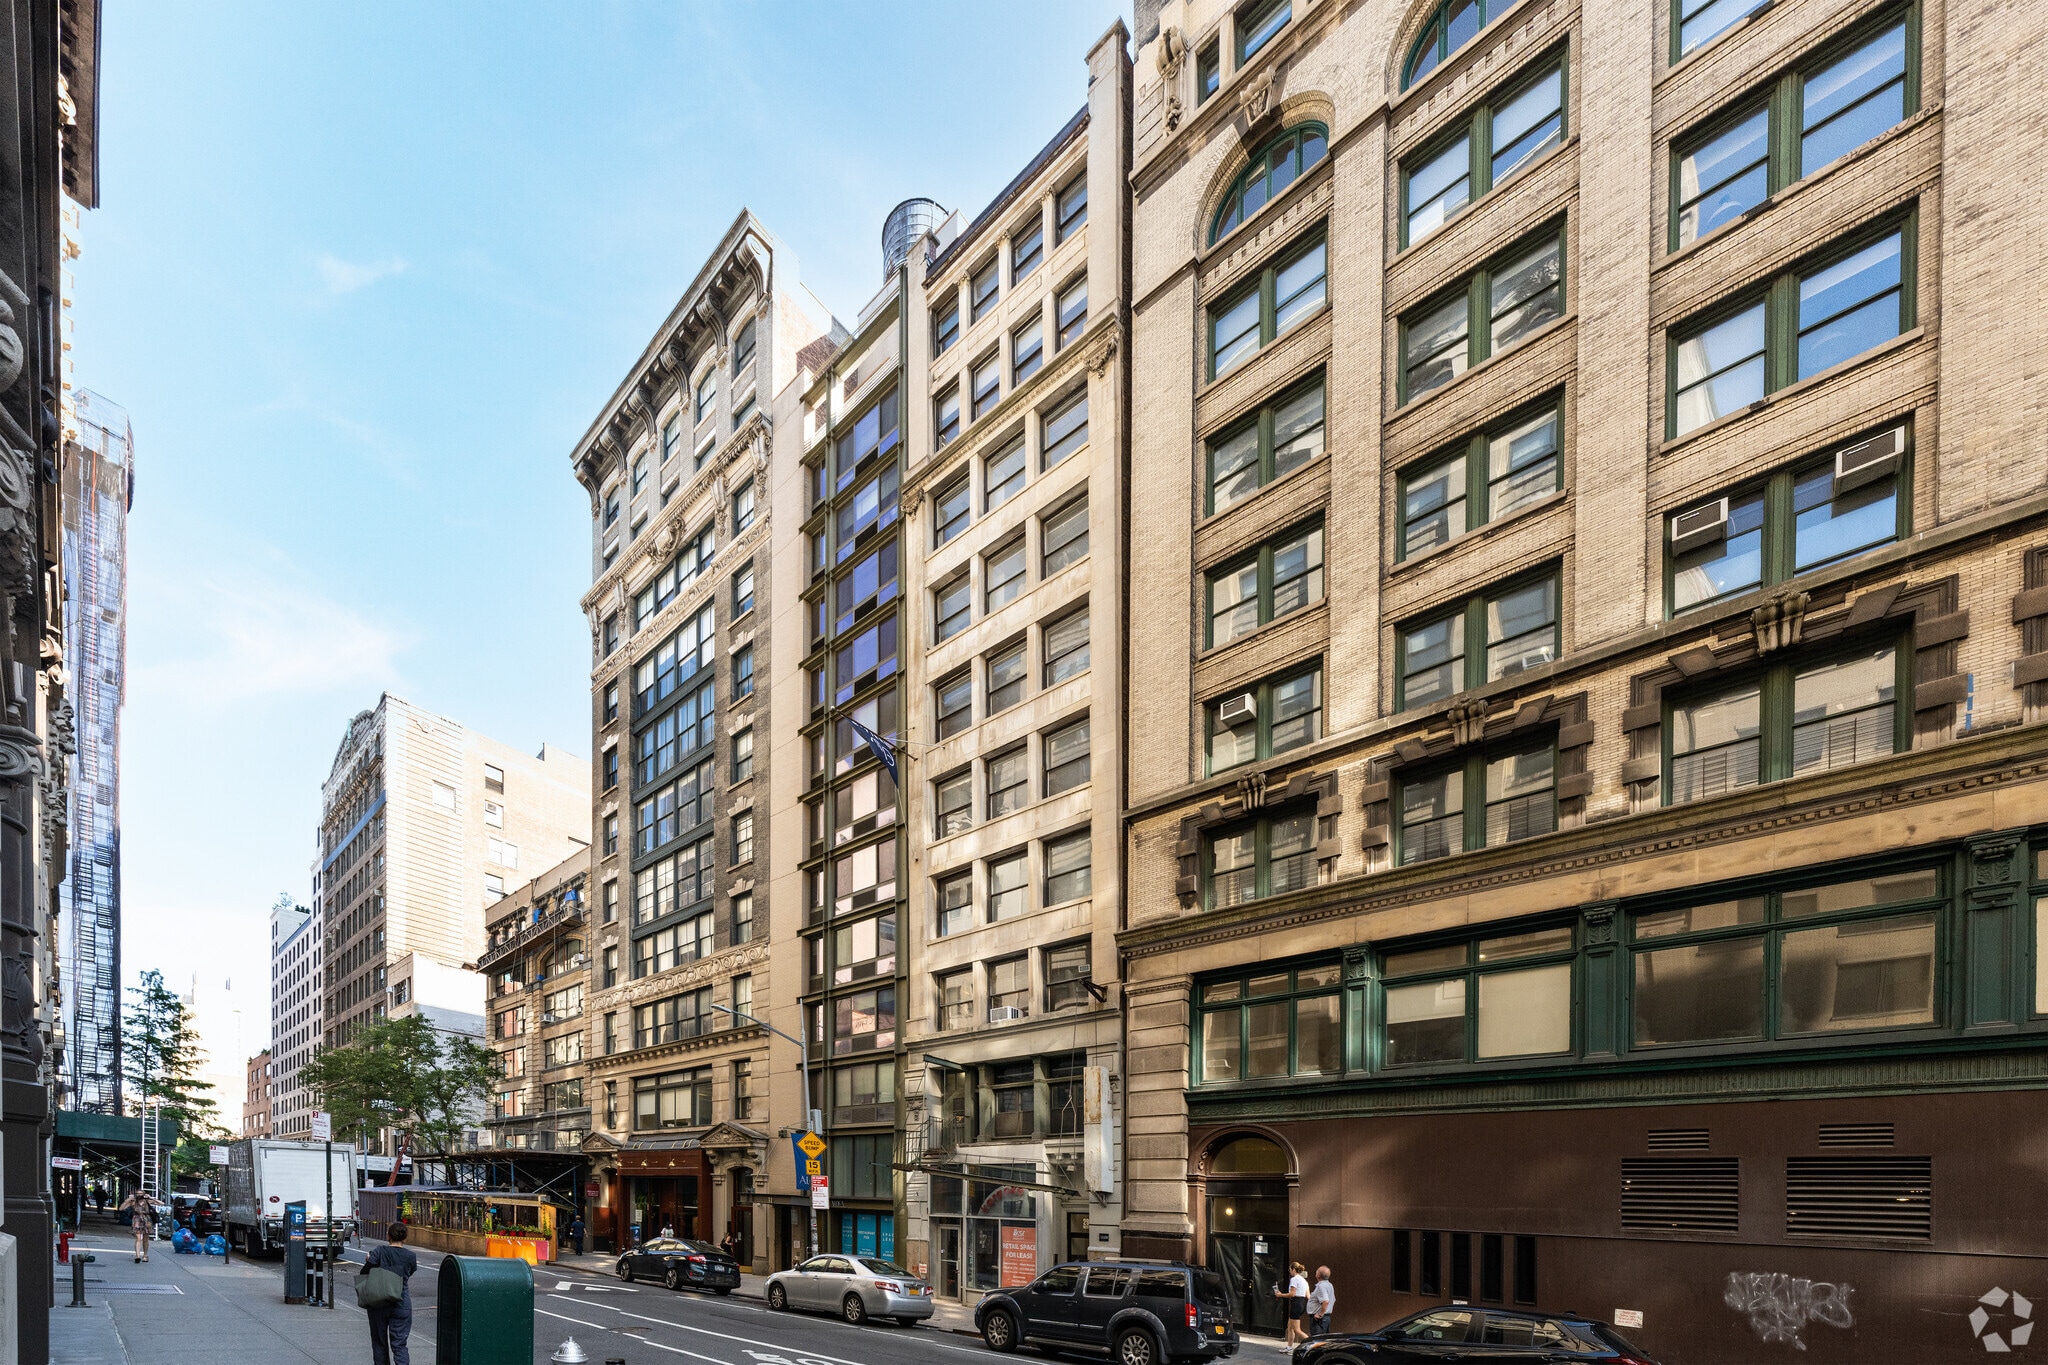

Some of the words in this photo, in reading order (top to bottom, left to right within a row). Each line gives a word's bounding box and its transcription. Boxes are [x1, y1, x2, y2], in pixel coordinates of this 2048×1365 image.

[808, 1161, 818, 1169] 15
[1002, 1242, 1019, 1250] RETAIL
[1020, 1243, 1036, 1251] SPACE
